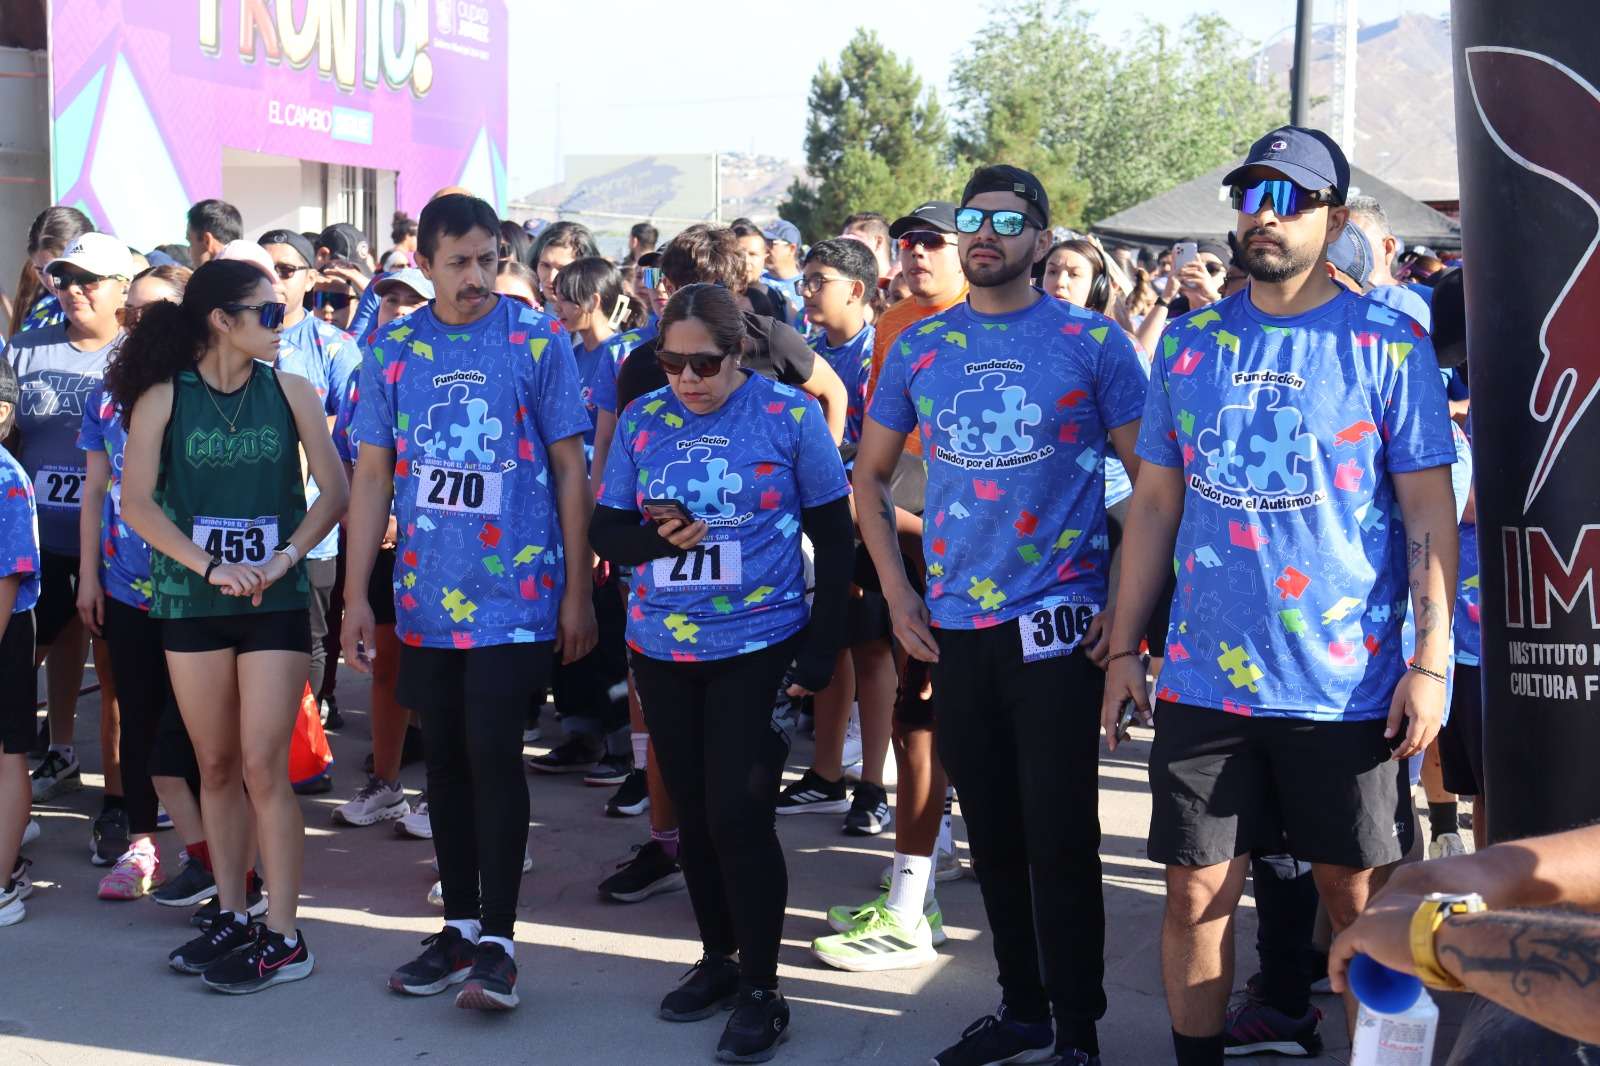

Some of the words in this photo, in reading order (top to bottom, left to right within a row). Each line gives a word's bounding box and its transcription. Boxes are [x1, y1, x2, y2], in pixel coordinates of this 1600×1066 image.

[435, 371, 485, 387] Fundación
[966, 360, 1023, 374] Fundación
[1234, 371, 1303, 388] Fundación
[21, 370, 97, 392] STA
[21, 391, 91, 416] WA
[937, 447, 964, 465] Unidos
[966, 459, 982, 468] por
[984, 458, 994, 468] el
[996, 453, 1038, 468] Autismo
[48, 473, 87, 503] 22
[428, 468, 485, 509] 270
[1191, 476, 1221, 499] Unidos
[1222, 497, 1243, 507] por
[1245, 498, 1256, 509] el
[1260, 495, 1312, 510] Autismo
[205, 527, 266, 563] 453
[670, 544, 721, 582] 271
[1031, 604, 1094, 648] 306
[1508, 641, 1588, 666] INSTITUTO
[1510, 672, 1579, 700] CULTURA
